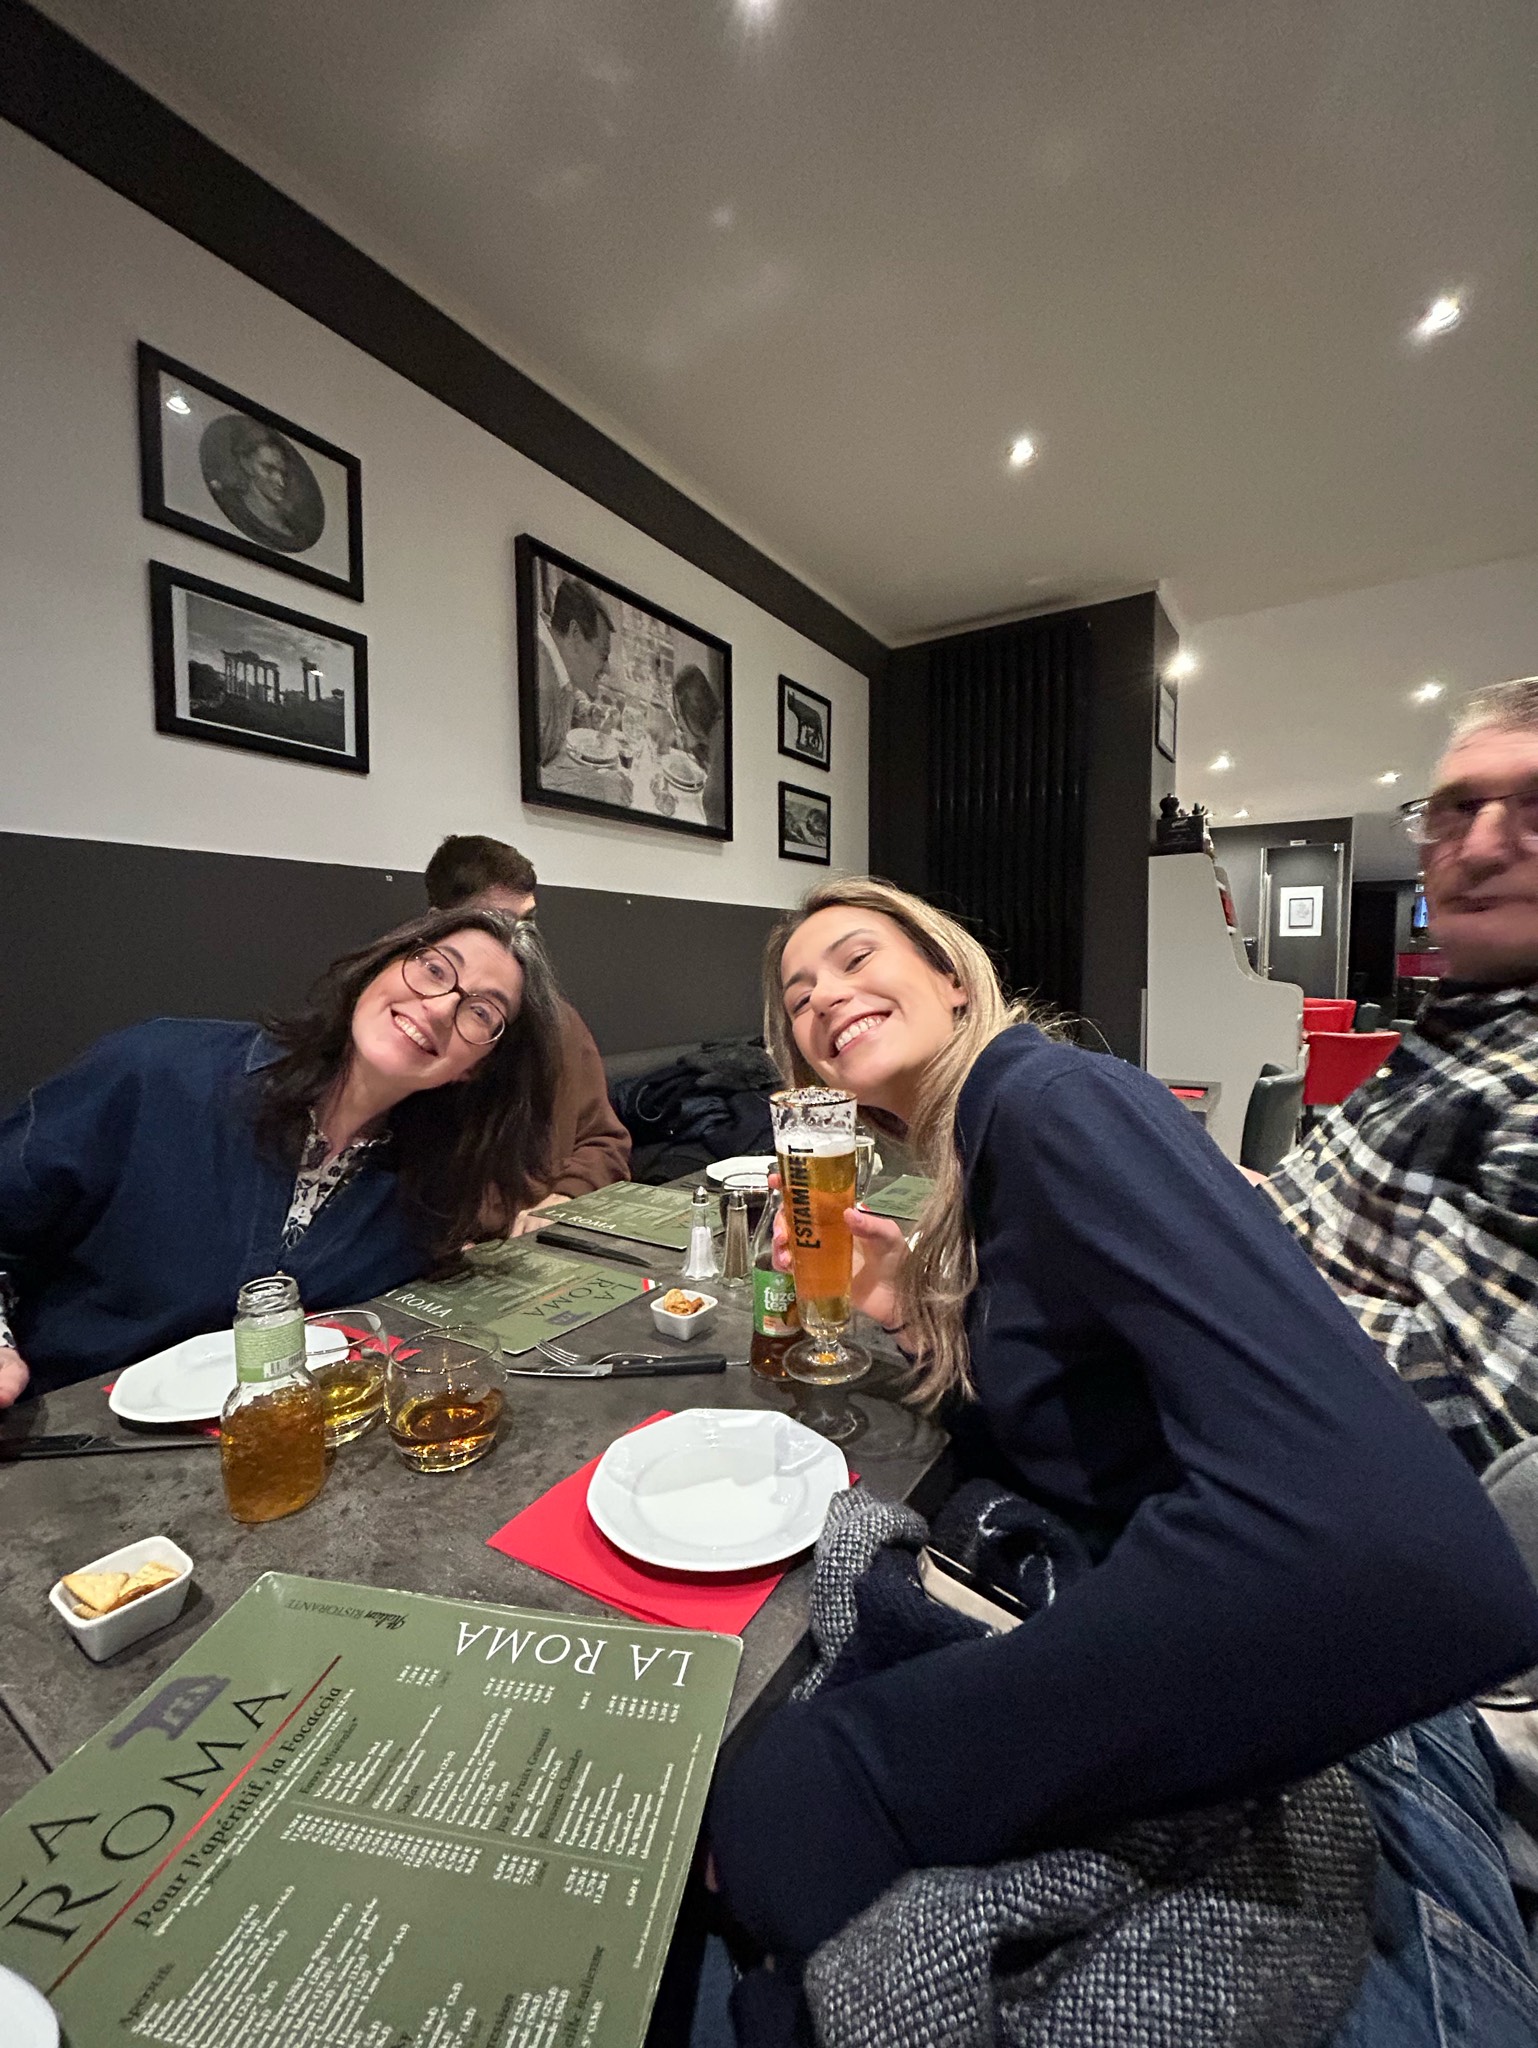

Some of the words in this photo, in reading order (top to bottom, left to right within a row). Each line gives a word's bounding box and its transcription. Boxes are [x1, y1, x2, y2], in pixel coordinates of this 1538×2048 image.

[788, 1145, 820, 1249] ESTAMINET
[546, 1210, 566, 1219] LA
[570, 1216, 617, 1231] ROMA
[396, 1292, 454, 1318] ROMA
[523, 1276, 607, 1317] ROMA
[764, 1287, 795, 1302] fuze
[764, 1299, 788, 1312] tea
[456, 1621, 607, 1676] ROMA
[630, 1644, 695, 1687] LA
[299, 1770, 322, 1794] Eaux
[399, 1784, 420, 1813] Sodas
[495, 1816, 509, 1832] Jus
[505, 1801, 516, 1813] de
[513, 1768, 532, 1796] Fruits
[5, 1688, 293, 1944] ROMA
[134, 1874, 184, 1930] Pour
[184, 1779, 271, 1868] l'apéritif,
[263, 1758, 284, 1776] la
[281, 1688, 342, 1751] Focaccia
[0, 1813, 100, 1911] A
[486, 1994, 513, 2047] ression
